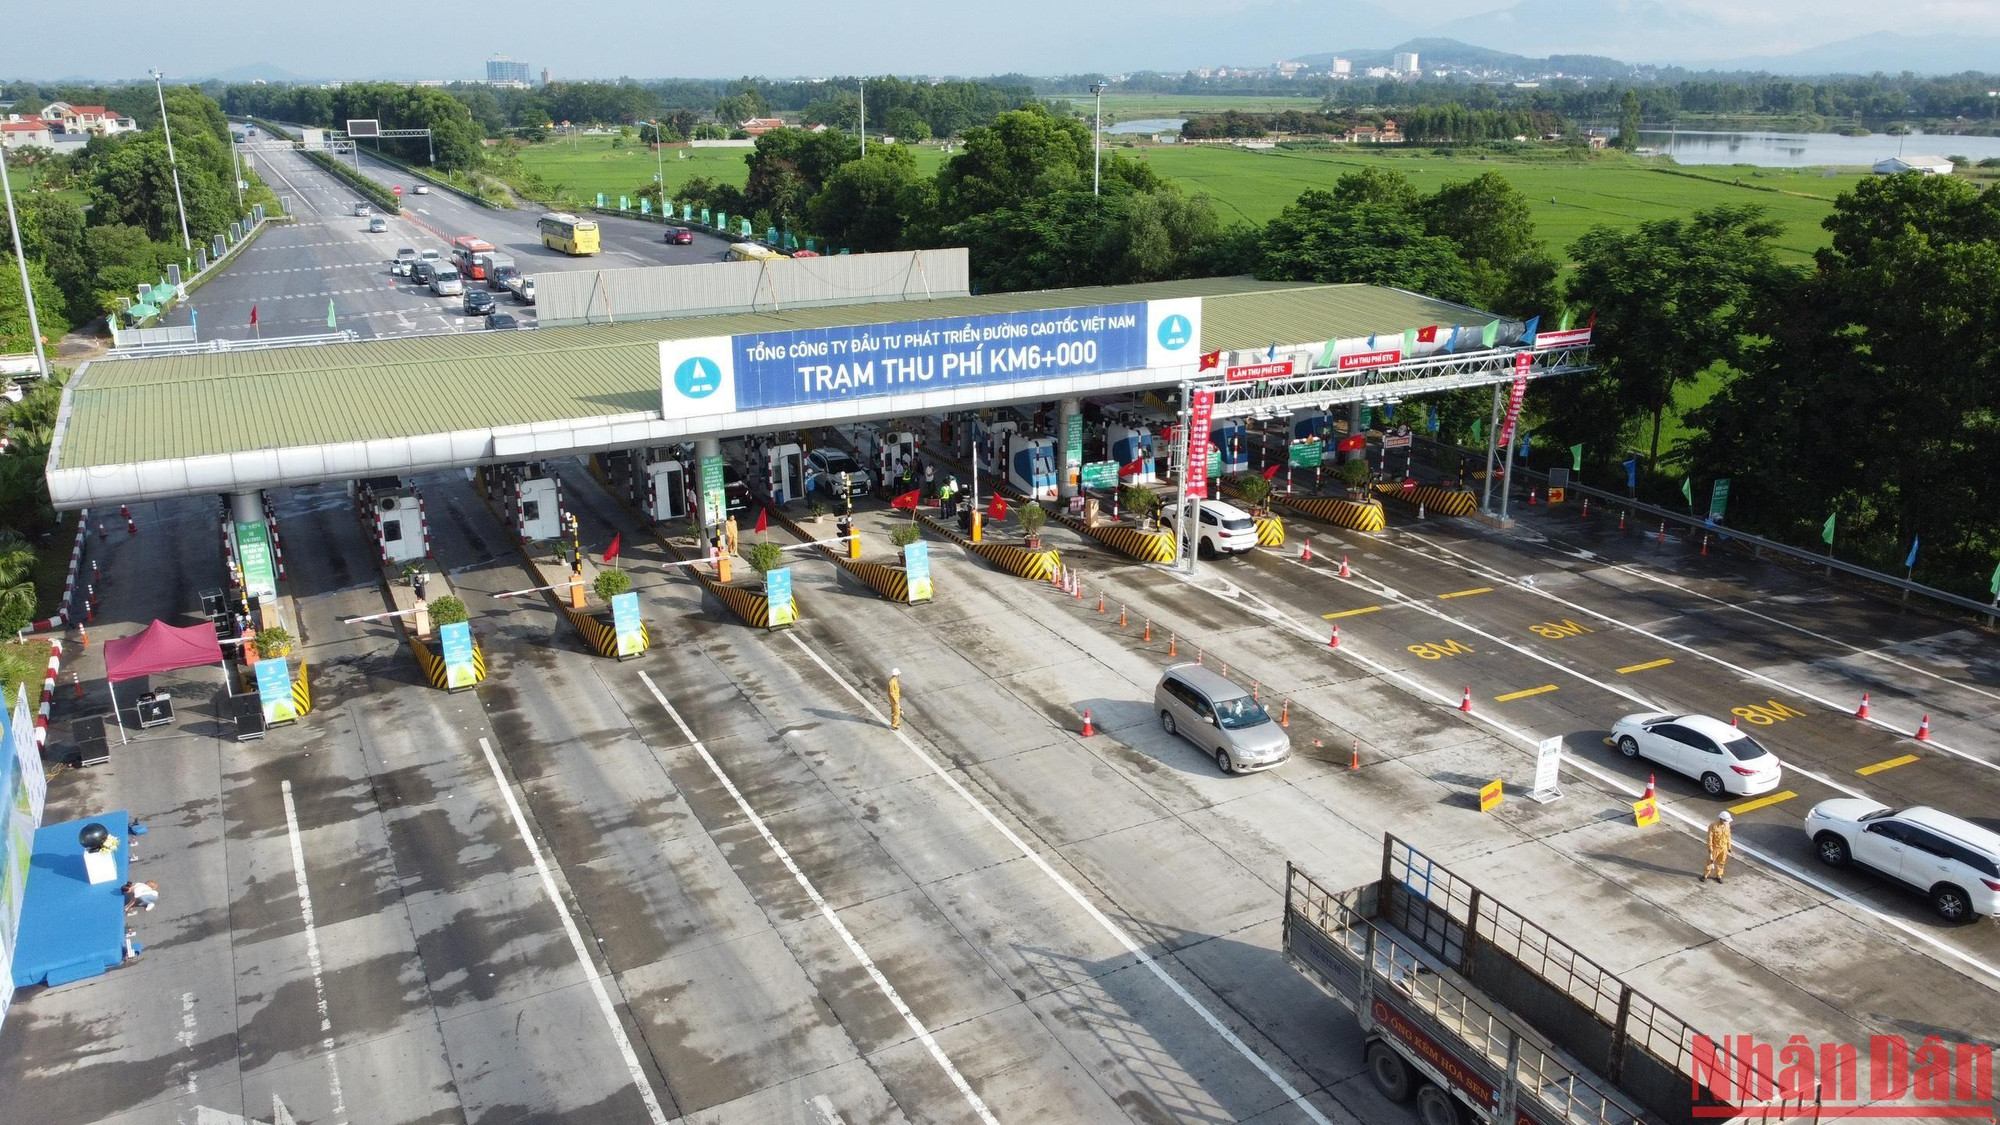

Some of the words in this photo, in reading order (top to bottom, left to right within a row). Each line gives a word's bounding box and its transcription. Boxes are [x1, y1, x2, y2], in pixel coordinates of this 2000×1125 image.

[747, 341, 785, 362] TỔNG
[789, 338, 828, 358] CÔNG
[831, 340, 848, 354] TY
[851, 333, 880, 353] ĐẦU
[883, 335, 902, 350] TƯ
[904, 330, 940, 348] PHÁT
[943, 323, 980, 345] TRIỂN
[983, 322, 1027, 341] ĐƯỜNG
[1081, 316, 1106, 334] VIỆT
[1108, 315, 1135, 329] NAM
[798, 361, 874, 394] TRẠM
[881, 355, 934, 384] THU
[942, 343, 984, 378] PHÍ
[990, 340, 1097, 373] KM6+000
[1232, 368, 1247, 378] LÀN
[1248, 367, 1261, 376] THU
[1262, 365, 1273, 376] PHÍ
[1273, 365, 1285, 374] ETC
[1345, 356, 1359, 366] LÀN
[1359, 356, 1371, 365] THU
[1371, 354, 1382, 364] PHÍ
[1382, 353, 1394, 362] ETC
[1528, 619, 1595, 639] 8M
[1406, 638, 1475, 660] 8M
[1731, 700, 1807, 726] 8M
[1440, 1058, 1464, 1082] HOA
[1466, 1077, 1489, 1101] SEN
